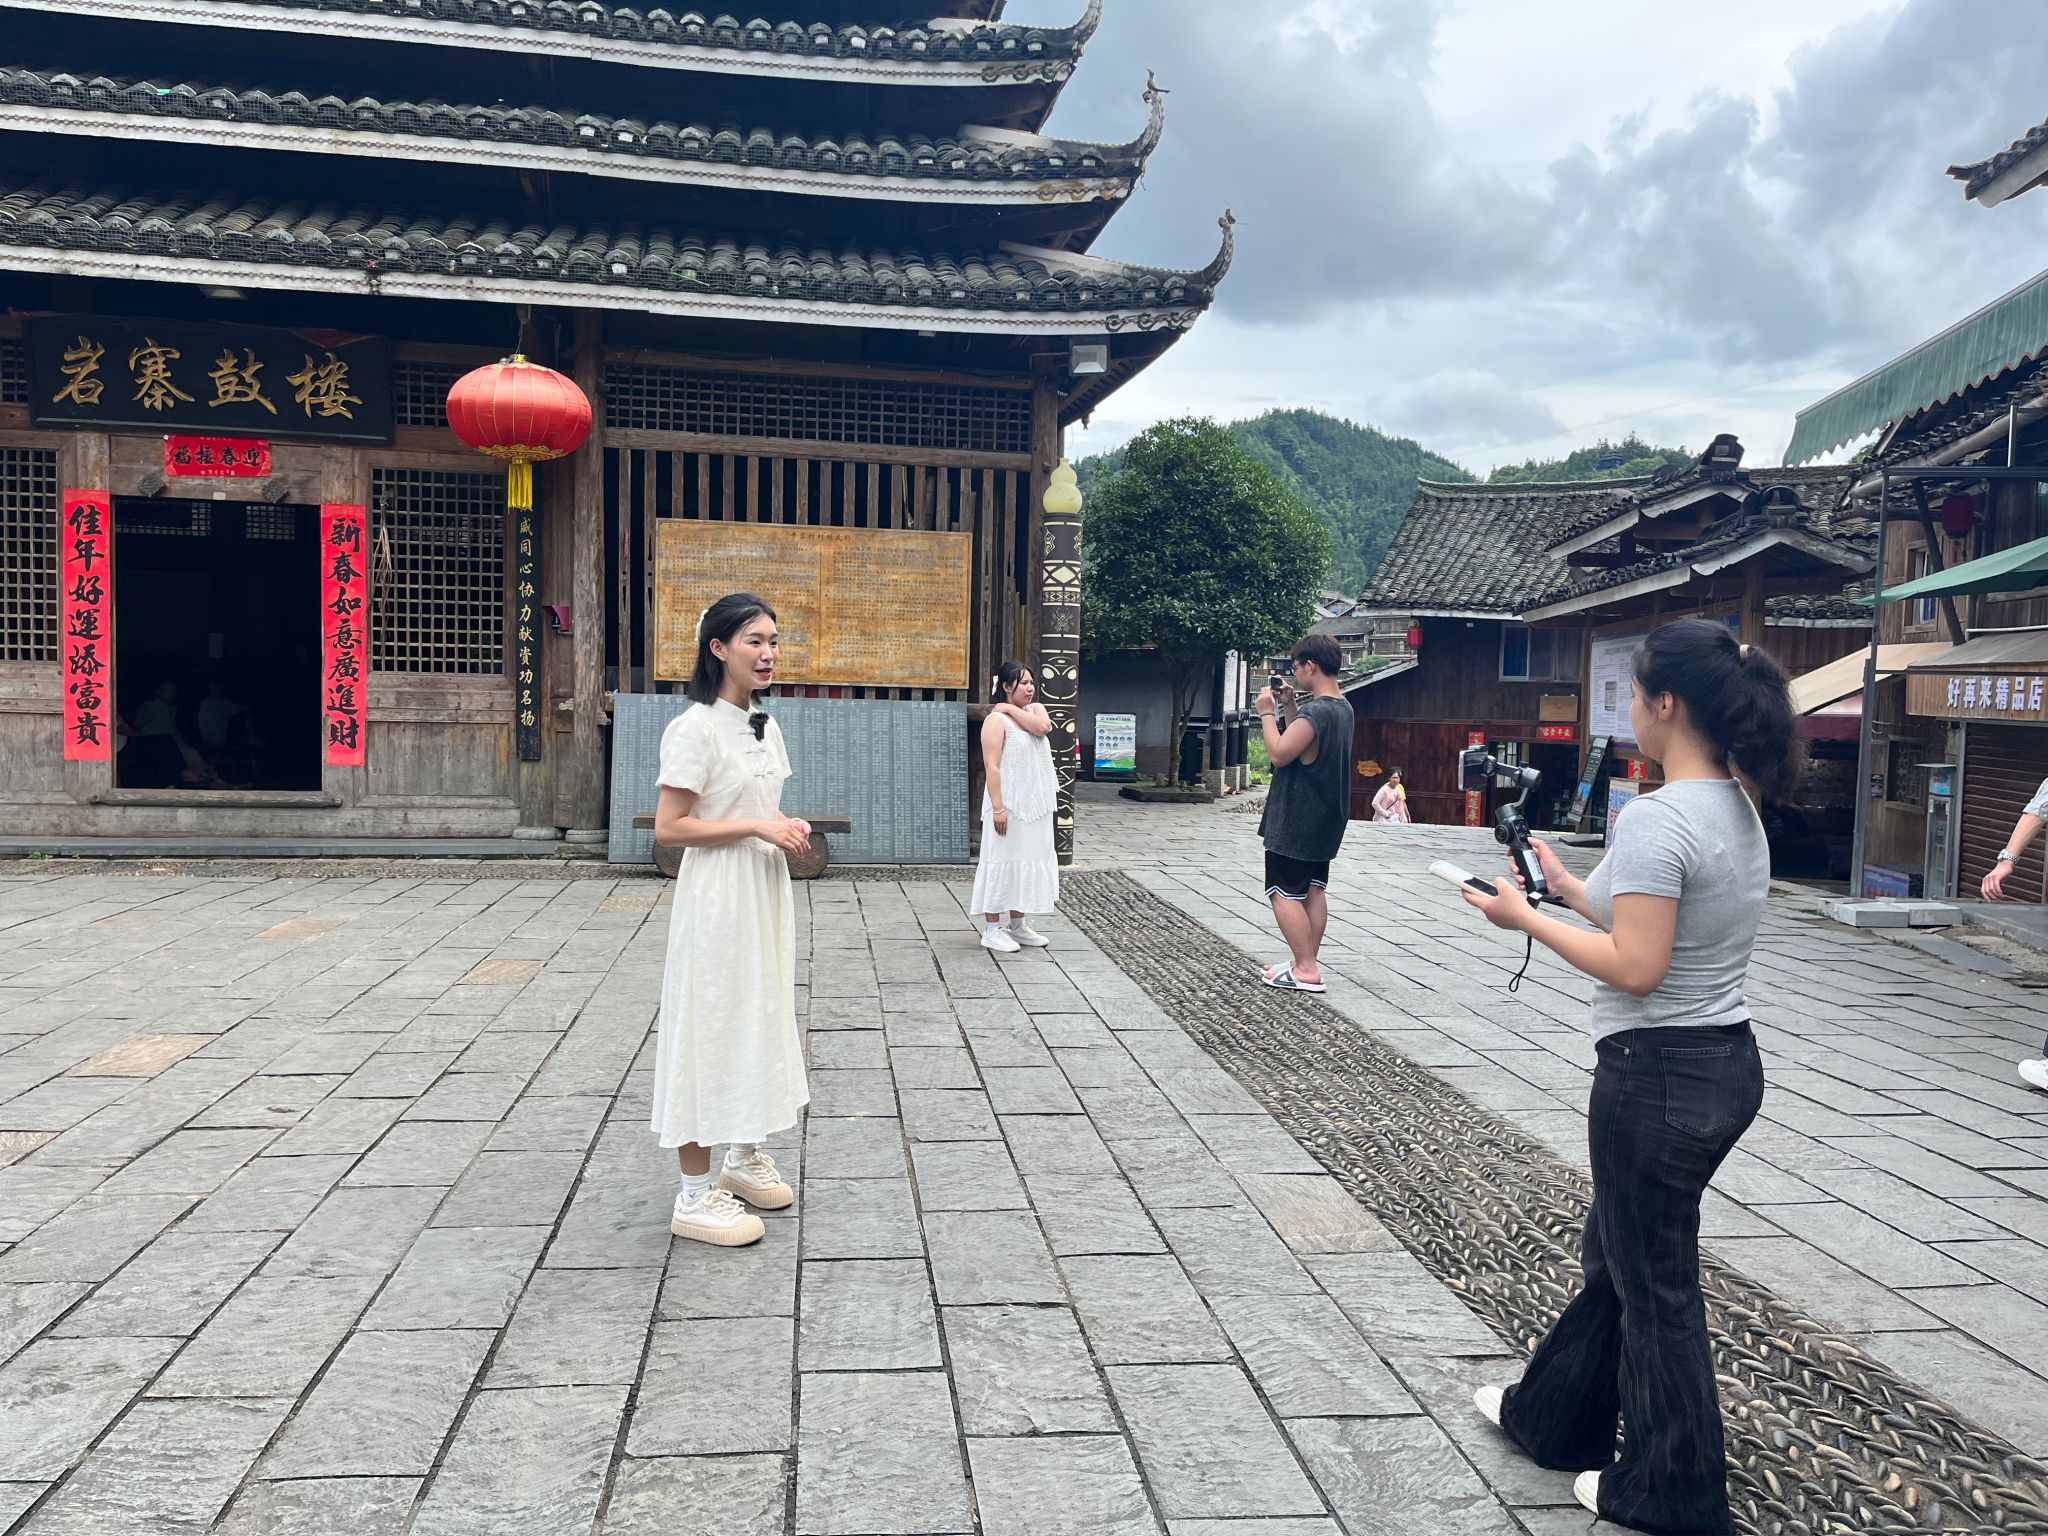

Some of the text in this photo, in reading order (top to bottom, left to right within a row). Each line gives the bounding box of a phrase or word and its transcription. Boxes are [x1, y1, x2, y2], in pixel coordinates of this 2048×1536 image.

[68, 504, 106, 746] 佳年好運添富貴
[326, 517, 362, 750] 新春如意廣進財
[1947, 676, 2043, 711] 好再来精品店
